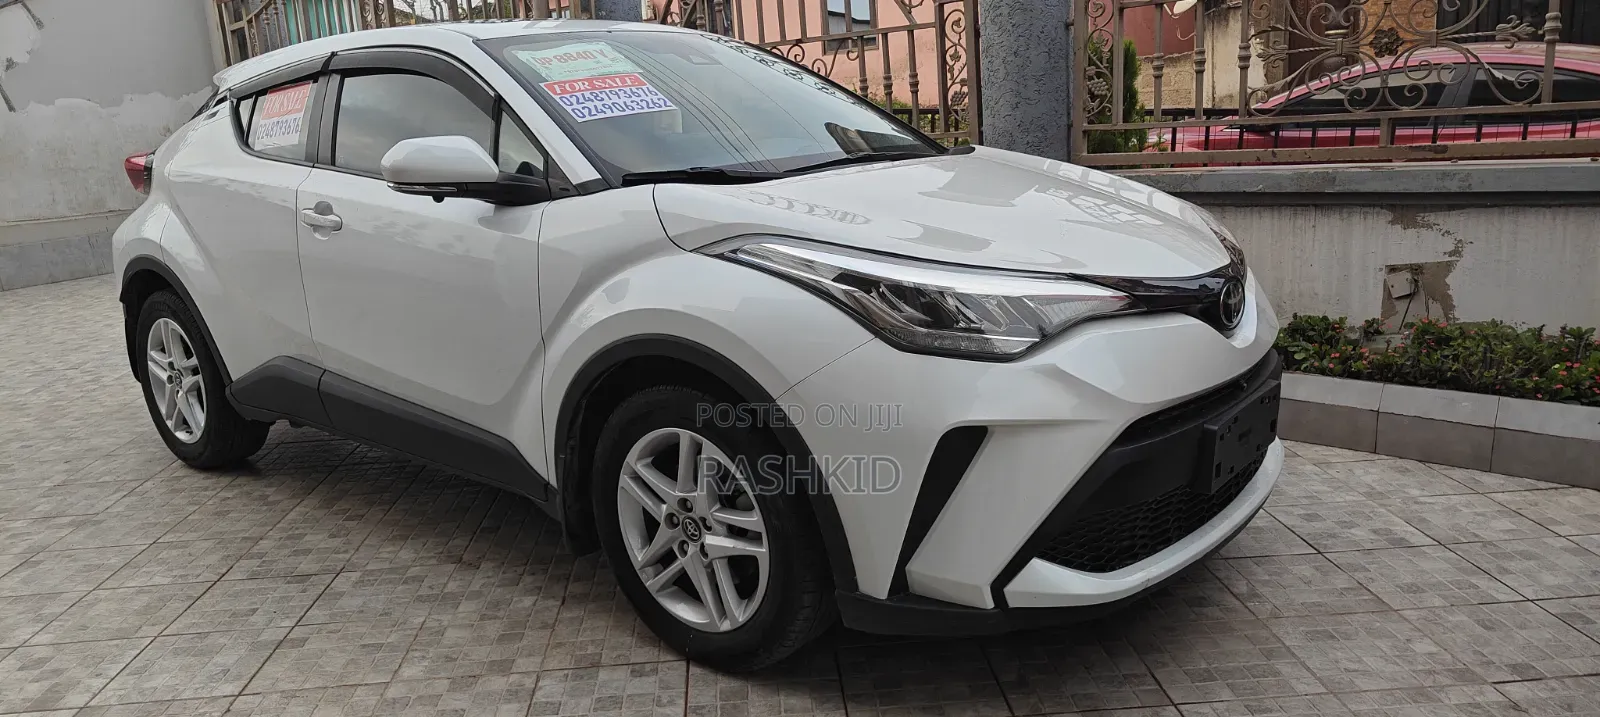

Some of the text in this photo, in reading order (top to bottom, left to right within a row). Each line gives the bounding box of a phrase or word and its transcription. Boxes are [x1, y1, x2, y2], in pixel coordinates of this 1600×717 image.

[553, 76, 639, 94] FOR SALE
[559, 86, 659, 107] 0248793676
[571, 97, 673, 119] 0249063262
